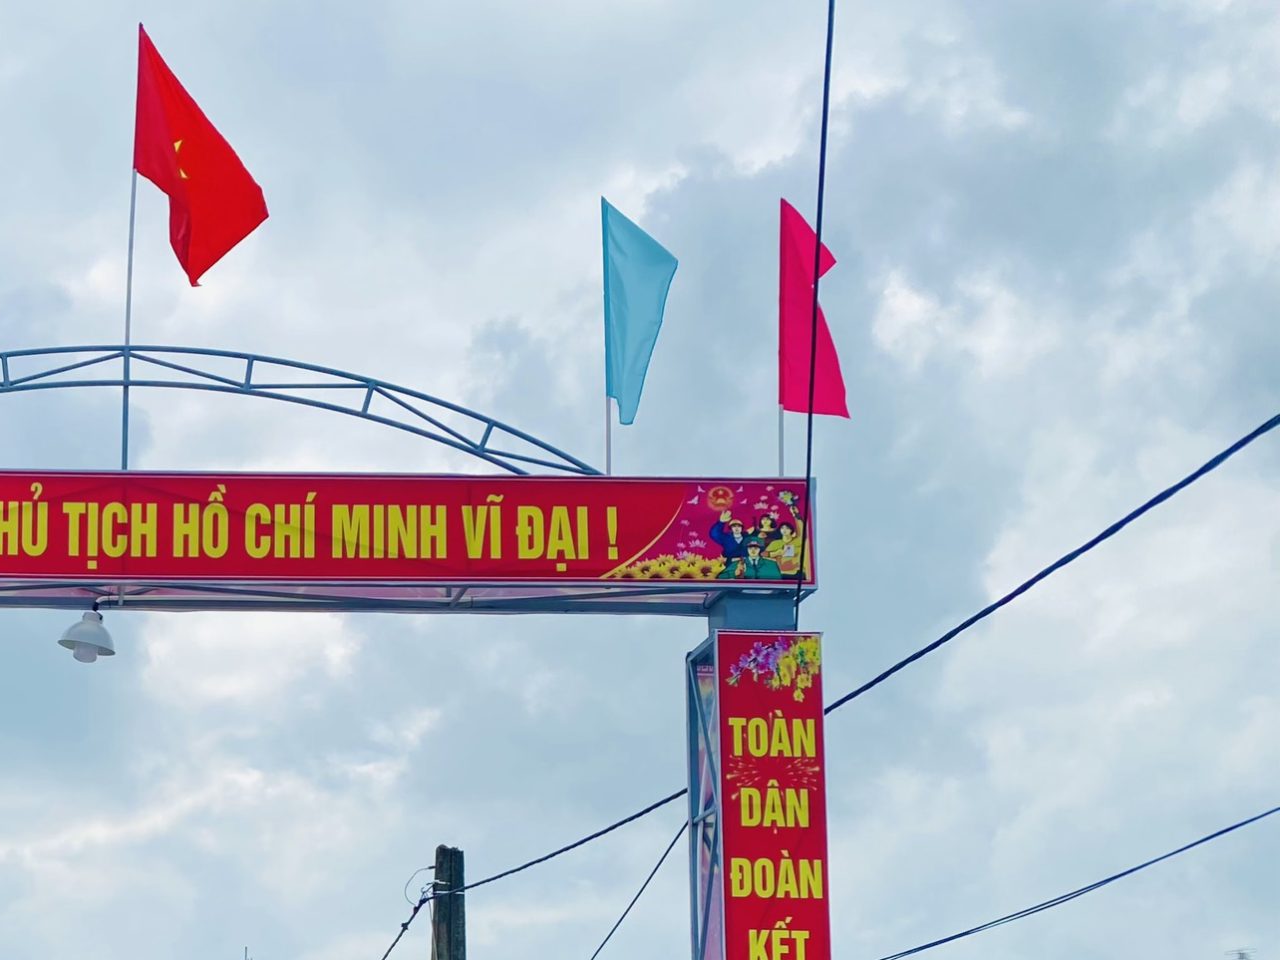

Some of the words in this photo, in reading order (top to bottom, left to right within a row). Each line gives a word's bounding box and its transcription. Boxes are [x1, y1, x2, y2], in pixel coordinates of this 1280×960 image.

[62, 501, 158, 570] TỊCH
[173, 484, 229, 559] HỒ
[244, 491, 318, 559] CHÍ
[331, 504, 448, 559] MINH
[461, 494, 505, 560] VĨ
[515, 505, 590, 572] ĐẠI
[606, 506, 619, 560] !
[728, 710, 816, 758] TOÀN
[740, 779, 809, 828] DÂN
[730, 849, 823, 899] ĐOÀN
